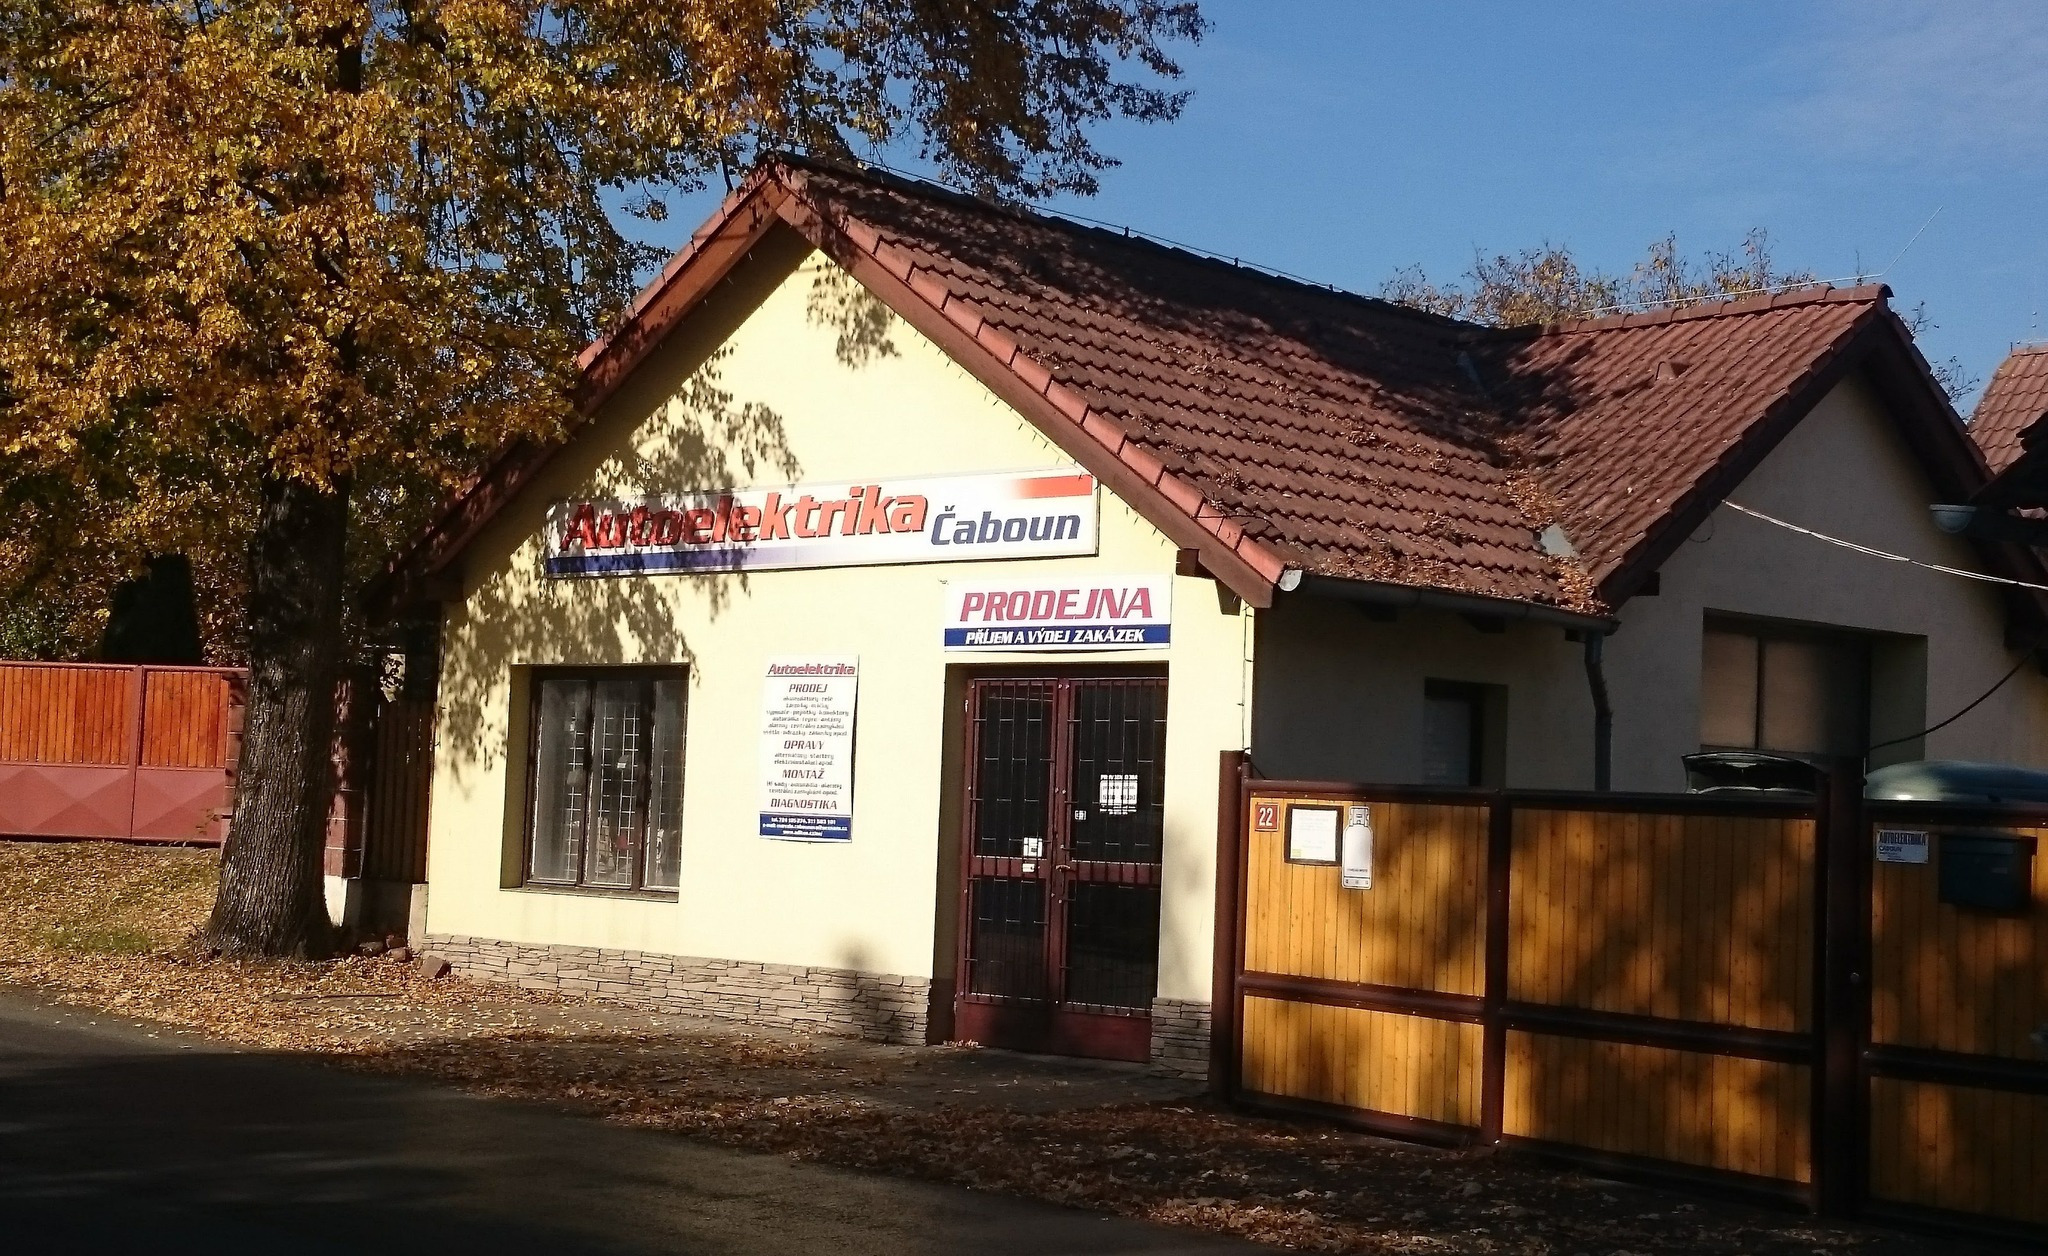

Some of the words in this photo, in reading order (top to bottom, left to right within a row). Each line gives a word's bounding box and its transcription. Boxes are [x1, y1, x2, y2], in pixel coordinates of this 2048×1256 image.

[560, 485, 928, 551] Autoelektrika
[931, 504, 1081, 545] Čaboun
[959, 587, 1153, 621] PRODEJNA
[965, 629, 1013, 645] PŘÍJEM
[1014, 631, 1025, 644] A
[1028, 628, 1070, 644] VÝDEJ
[1072, 627, 1145, 643] ZAKÁZEK
[768, 663, 856, 675] Autoelektrika
[789, 683, 828, 693] PRODEJ
[784, 740, 824, 750] OPRAVY
[782, 767, 825, 779] MONTAŽ
[770, 798, 838, 810] DIAGNOSTIKA
[1259, 807, 1273, 826] 22
[1879, 831, 1926, 846] AUTOELEKTRIKA
